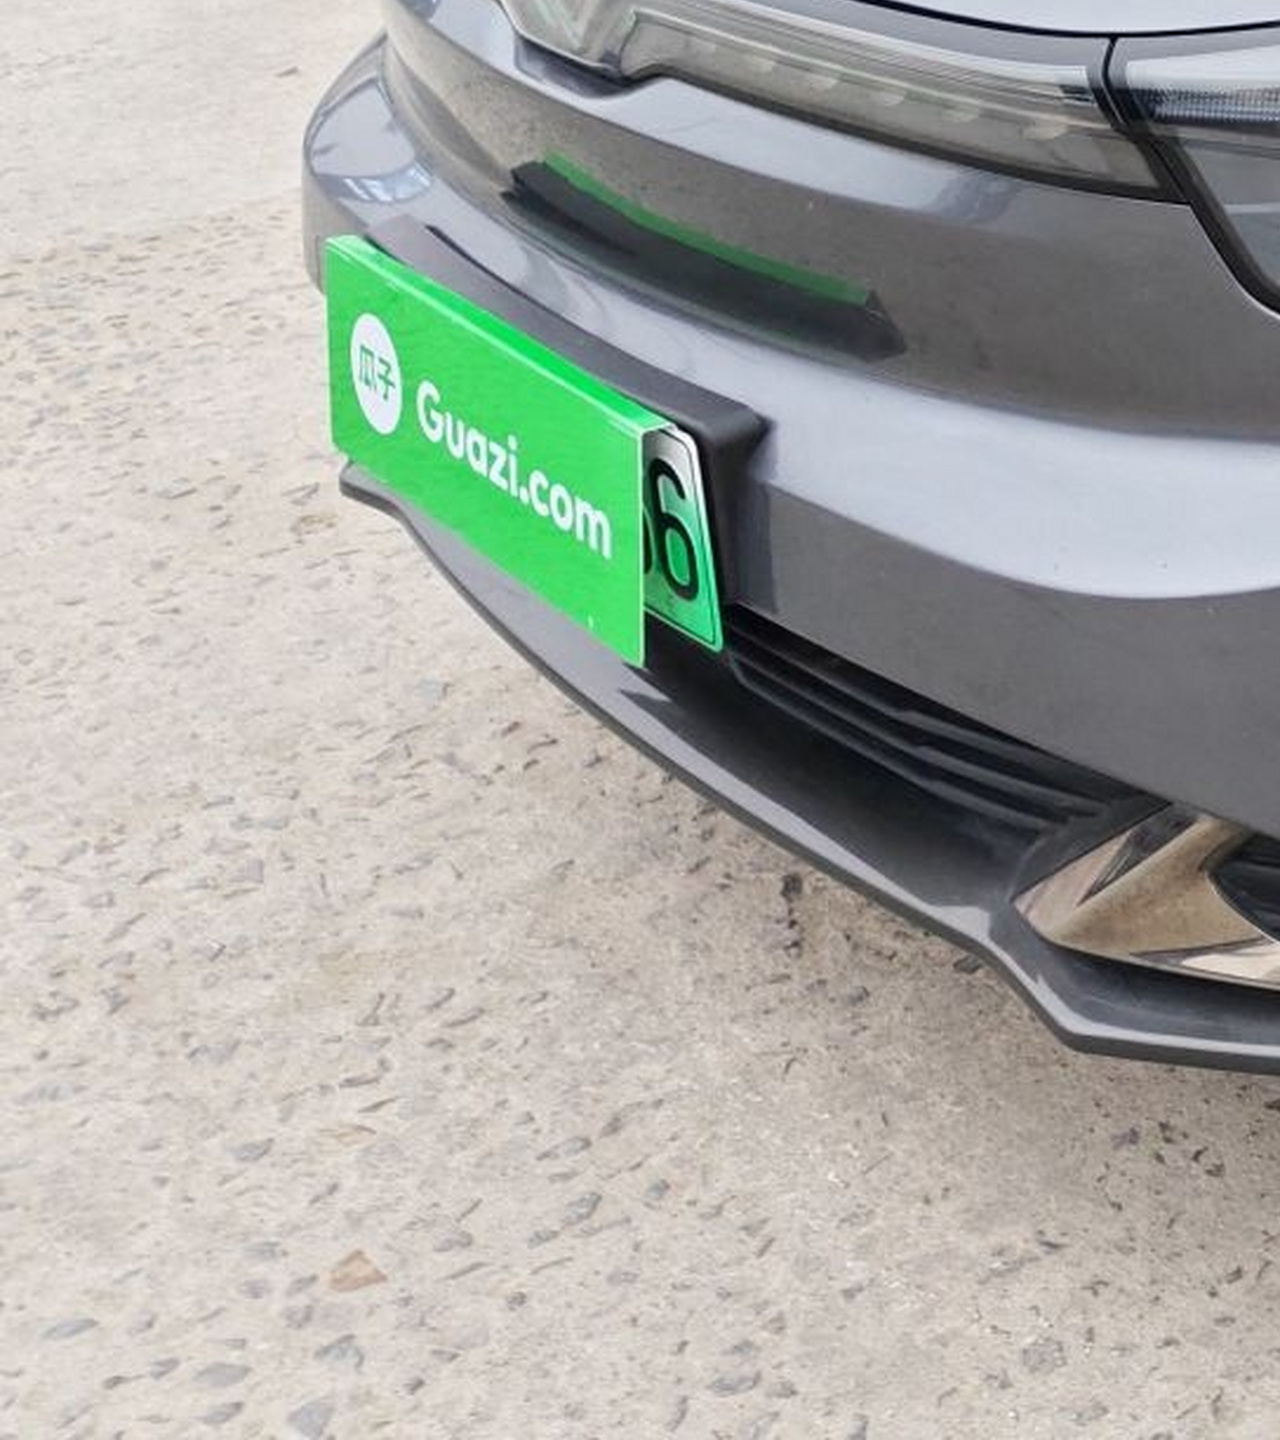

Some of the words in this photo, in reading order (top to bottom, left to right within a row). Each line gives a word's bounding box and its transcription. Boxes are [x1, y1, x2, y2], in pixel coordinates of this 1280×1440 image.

[358, 343, 397, 401] 瓜子
[416, 379, 613, 559] Guazi.com
[643, 457, 700, 602] 6
